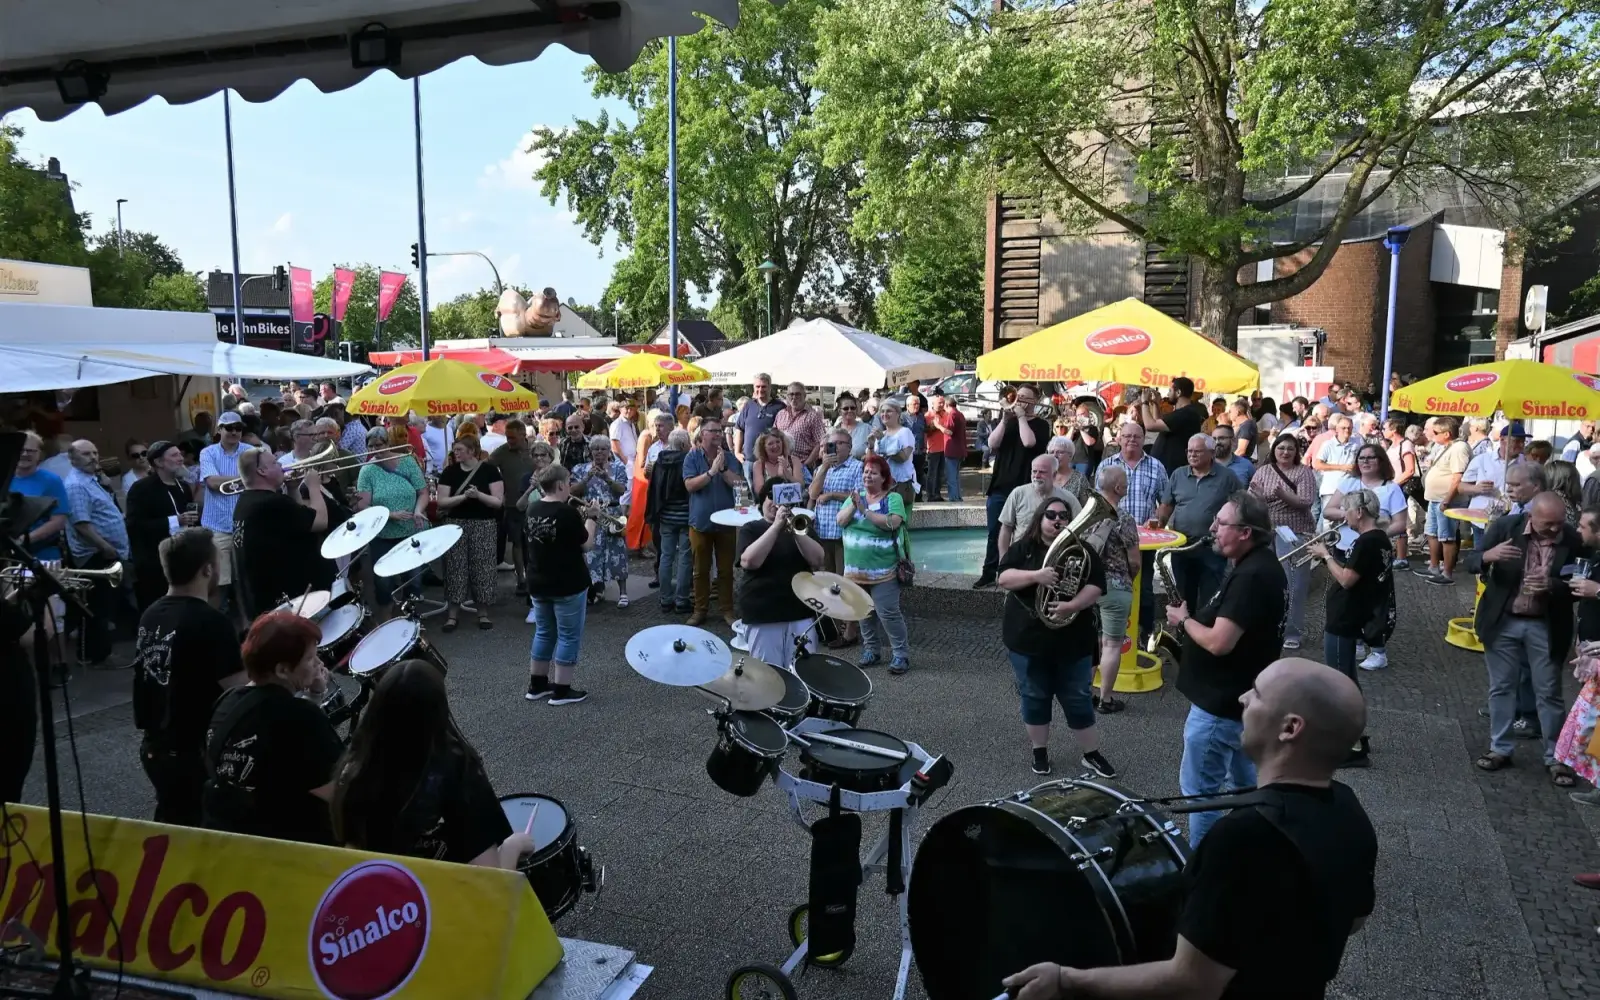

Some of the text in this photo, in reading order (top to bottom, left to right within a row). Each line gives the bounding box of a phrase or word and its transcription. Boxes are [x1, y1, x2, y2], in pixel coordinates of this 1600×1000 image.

[1091, 333, 1146, 350] Sinalco
[1019, 363, 1080, 380] Sinalco
[1450, 375, 1495, 388] Sinalco
[359, 400, 400, 415] Sinalco
[427, 399, 478, 414] Sinalco
[500, 397, 530, 412] Sinalco
[1425, 396, 1480, 414] Sinalco
[1522, 400, 1587, 418] Sinalco
[319, 901, 419, 966] Sinalco
